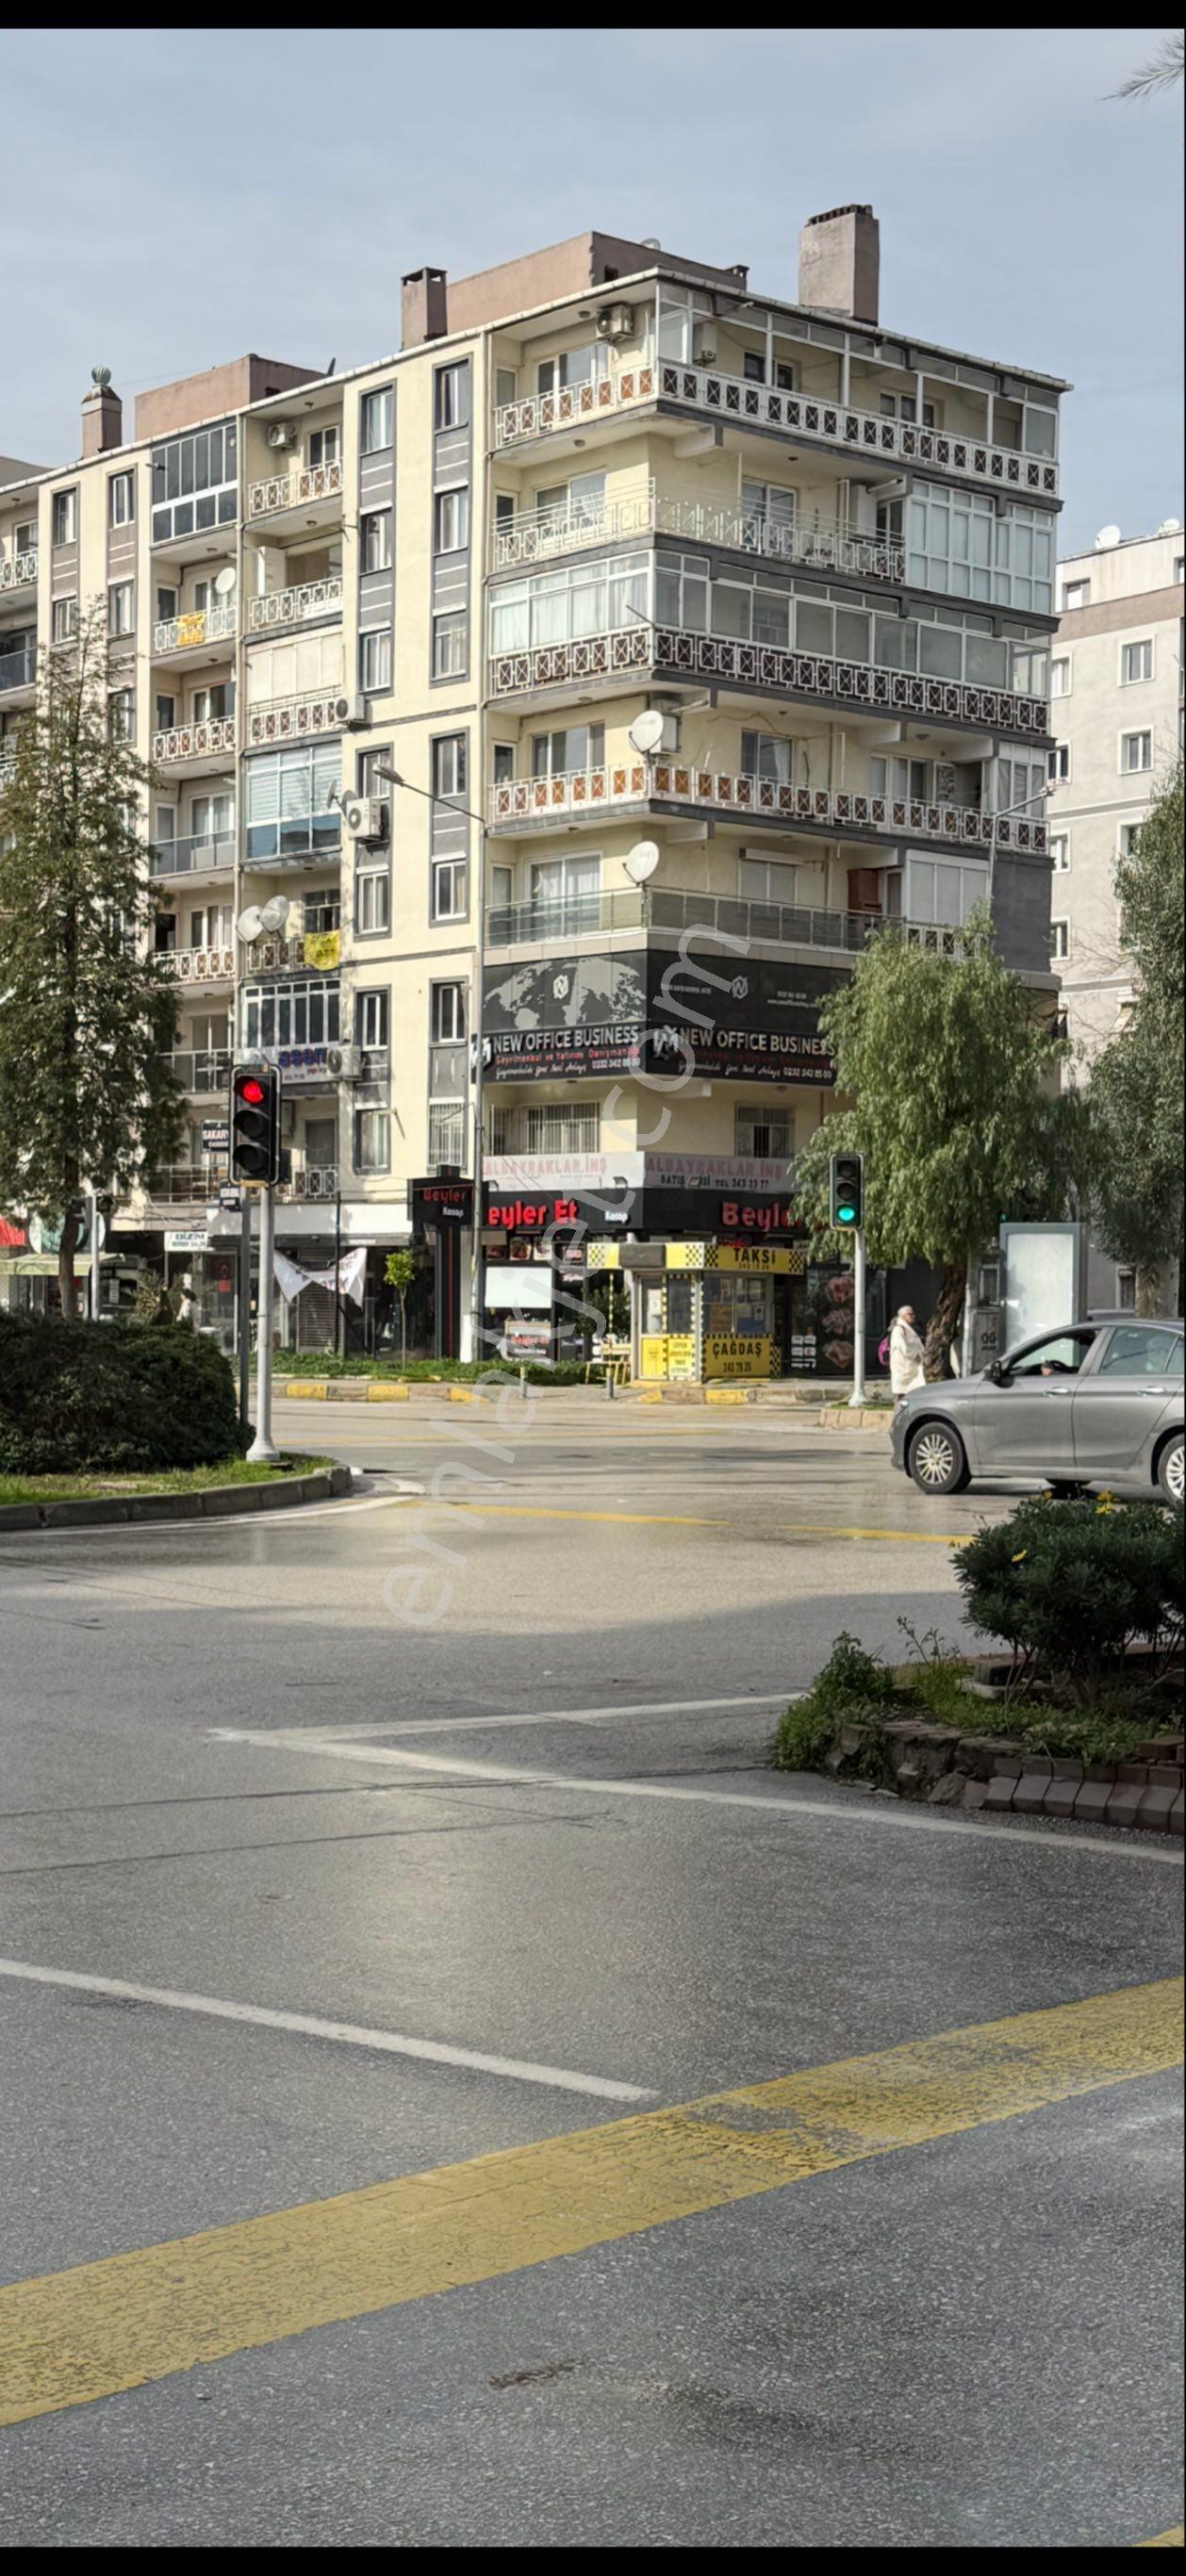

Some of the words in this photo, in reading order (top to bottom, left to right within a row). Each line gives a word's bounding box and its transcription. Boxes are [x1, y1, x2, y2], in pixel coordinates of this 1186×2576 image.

[493, 1035, 524, 1054] NEW
[525, 1032, 572, 1050] OFFICE
[574, 1025, 640, 1047] BUSINESS
[680, 1026, 713, 1046] NEW
[717, 1031, 766, 1051] OFFICE
[716, 1179, 729, 1188] TEL
[732, 1178, 746, 1188] 343
[487, 1200, 549, 1230] eyler
[553, 1199, 578, 1223] Et
[733, 1247, 777, 1265] TAKSİ
[712, 1340, 763, 1360] ÇAĞDAŞ
